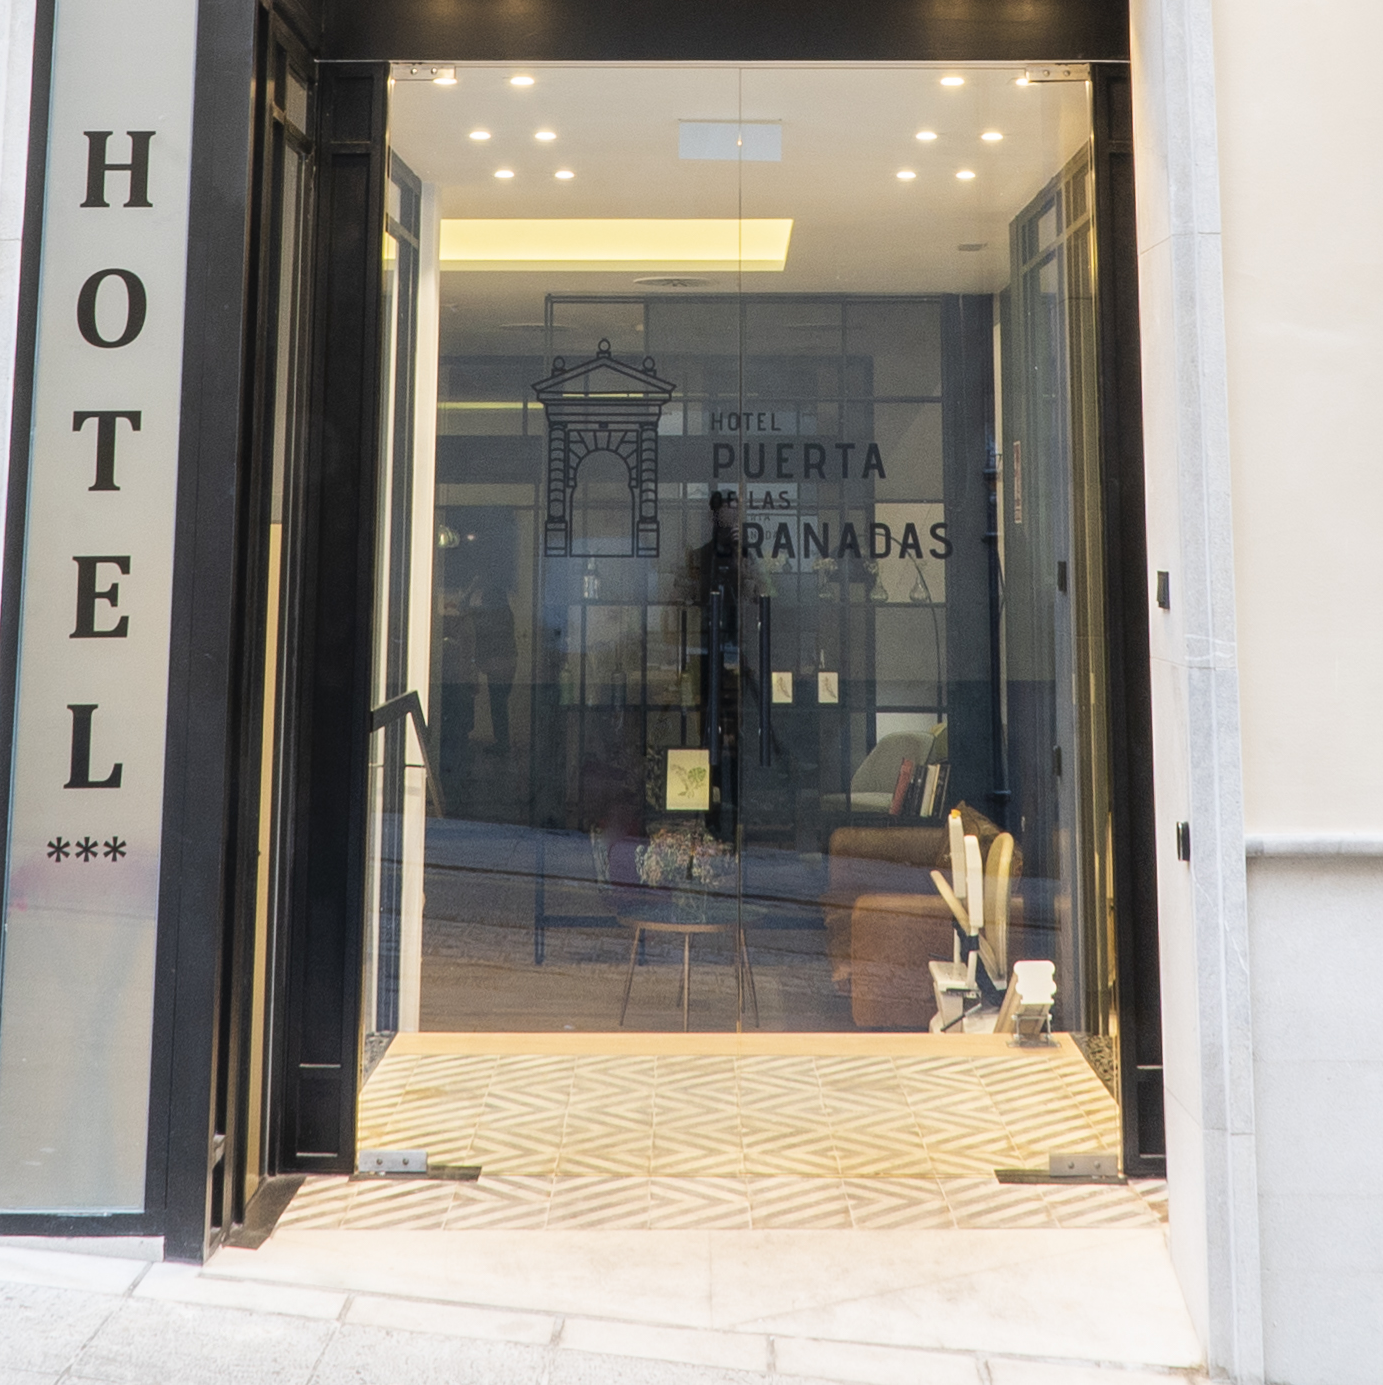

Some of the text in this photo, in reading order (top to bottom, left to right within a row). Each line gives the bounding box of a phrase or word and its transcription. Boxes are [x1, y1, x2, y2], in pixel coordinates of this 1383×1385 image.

[711, 412, 782, 431] HOTEL
[64, 131, 156, 789] HOTEL
[713, 442, 887, 479] PUERTA
[749, 490, 791, 510] LAS
